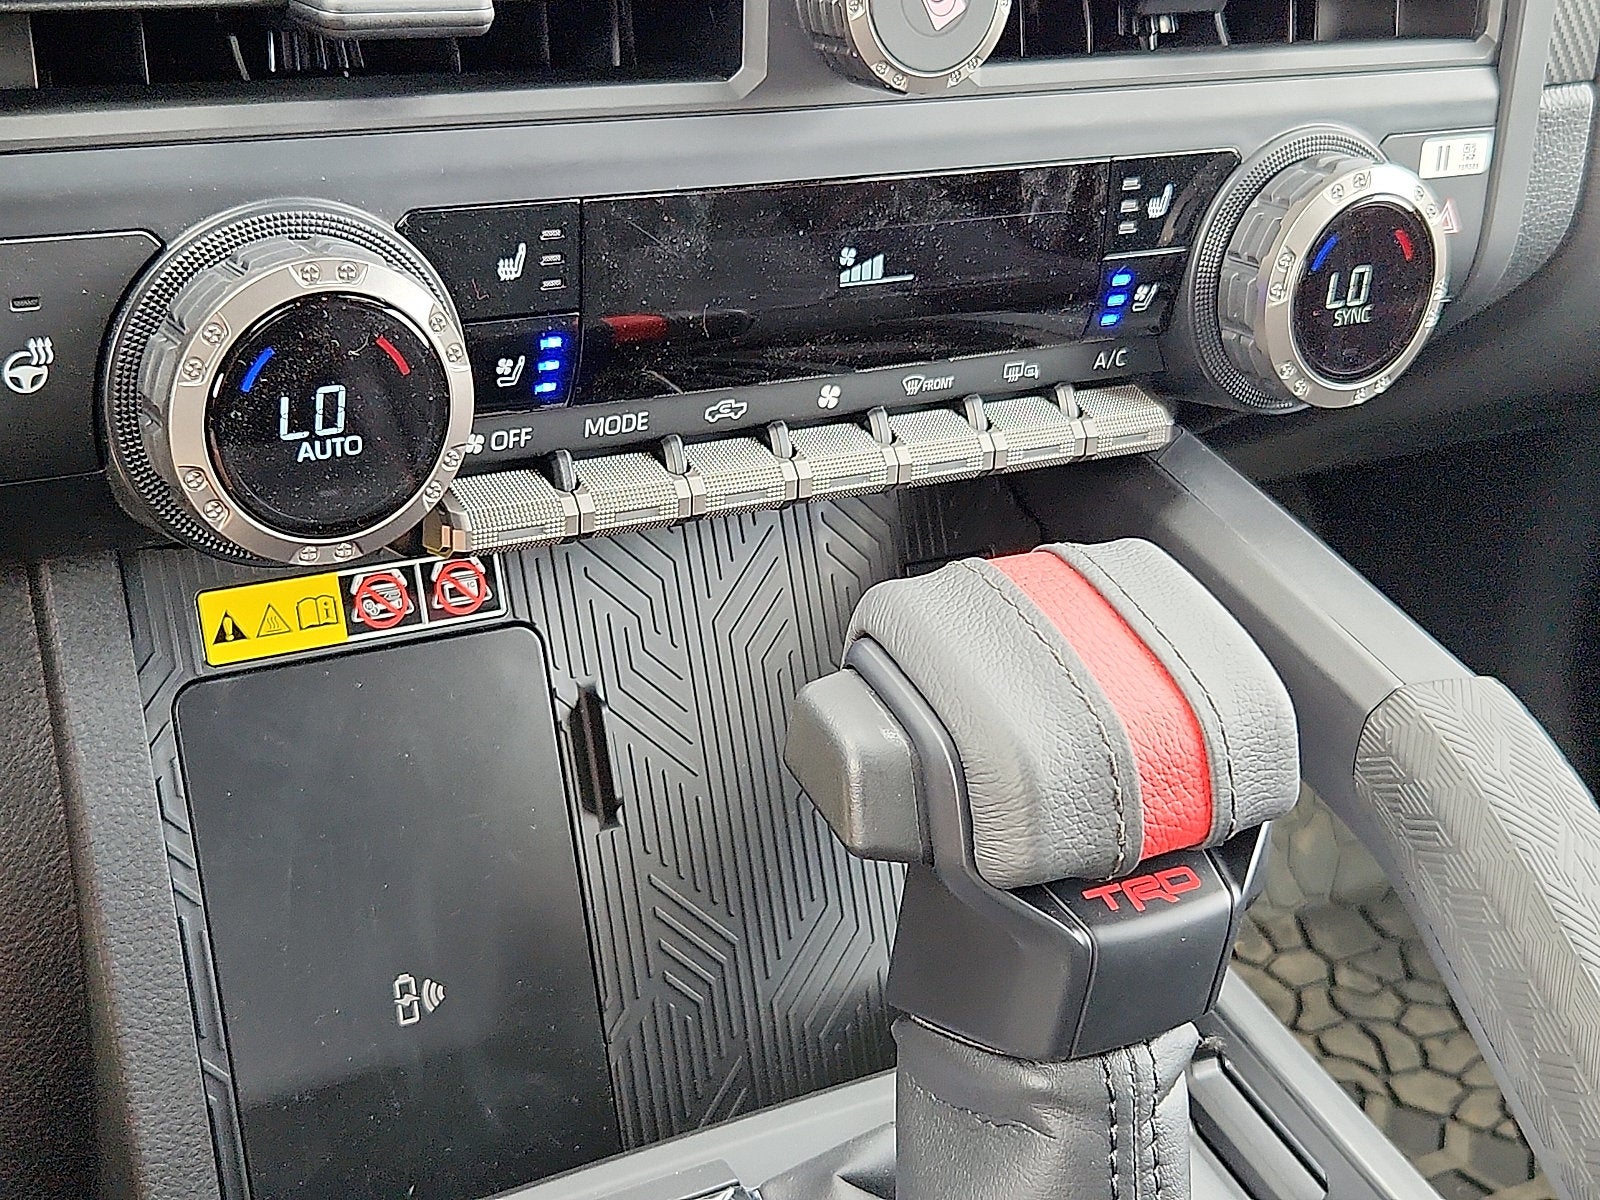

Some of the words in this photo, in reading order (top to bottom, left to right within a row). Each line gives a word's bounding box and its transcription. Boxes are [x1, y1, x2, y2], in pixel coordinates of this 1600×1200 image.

[1333, 304, 1375, 327] SYNC
[1093, 349, 1128, 371] A/C
[921, 376, 955, 392] FRONT
[584, 411, 650, 438] MODE
[296, 435, 363, 463] AUTO
[490, 427, 533, 451] OFF
[1081, 866, 1202, 912] TRD
